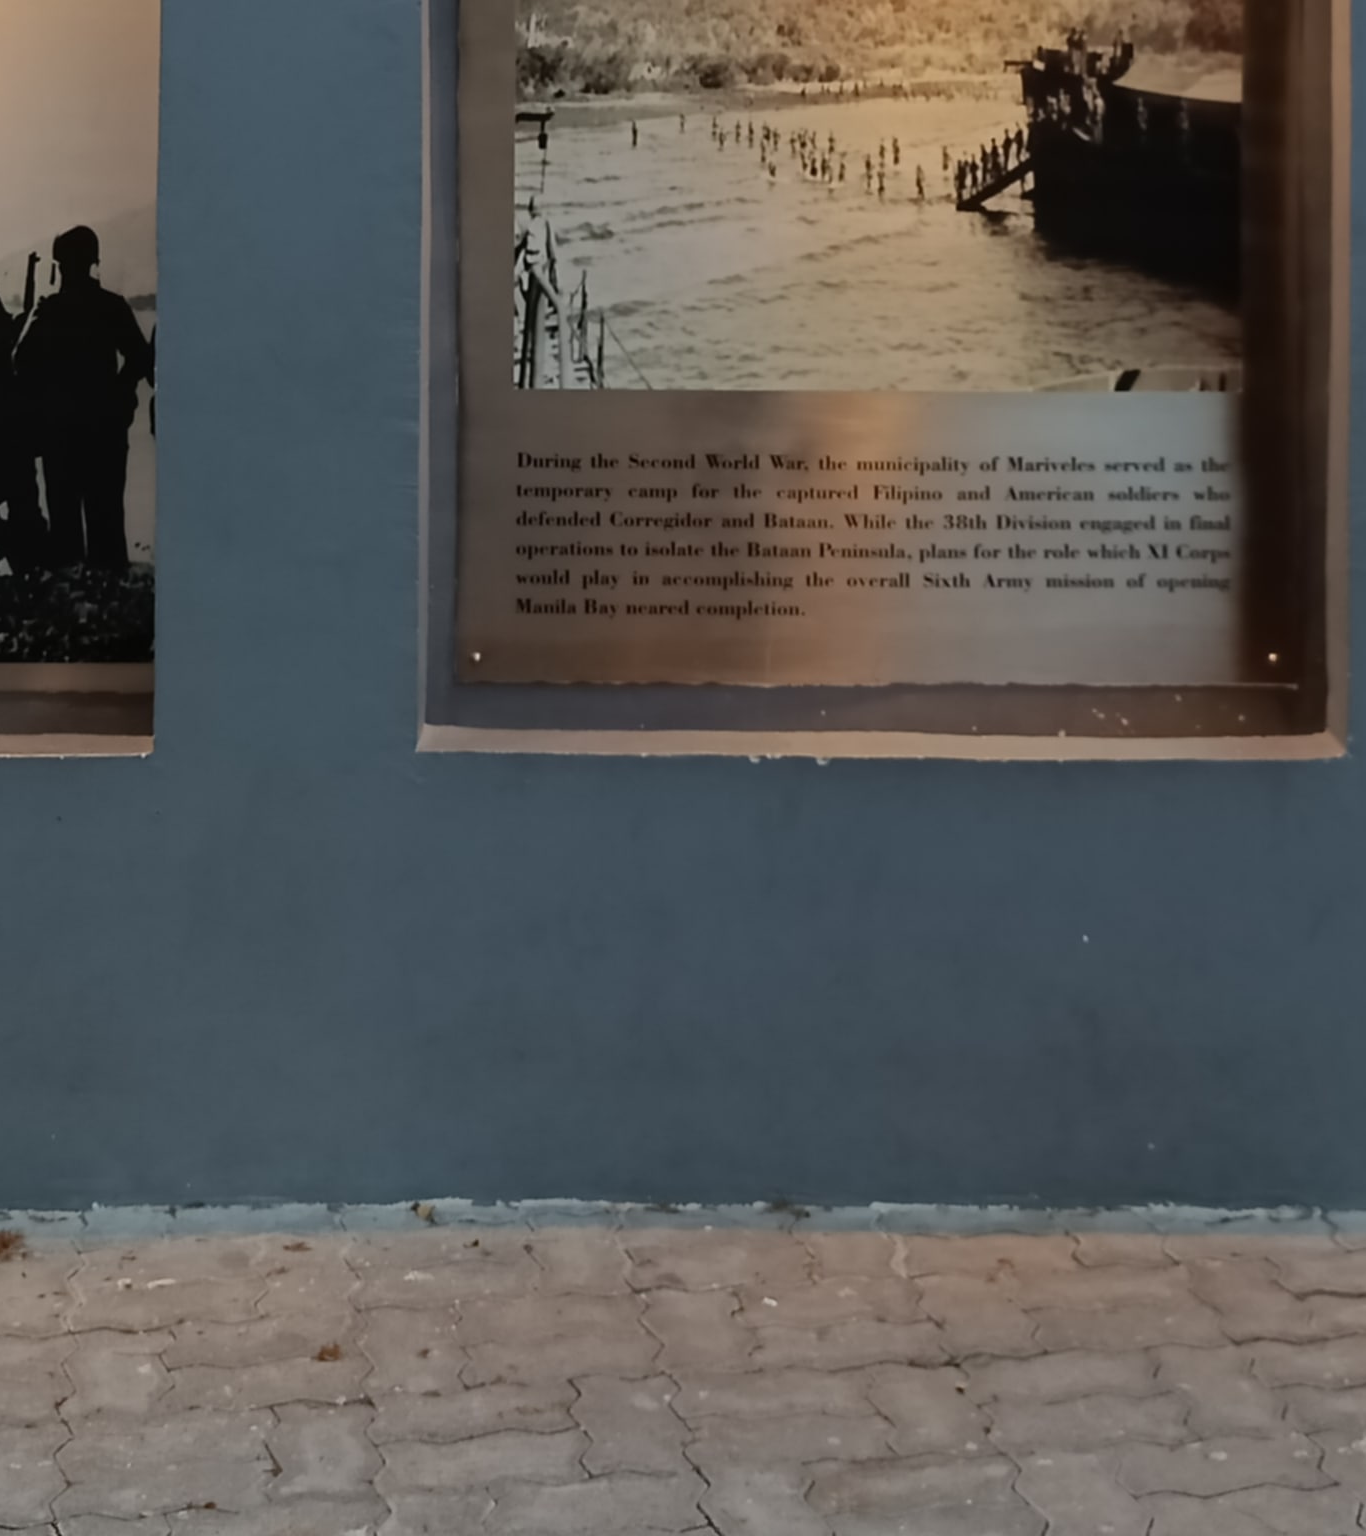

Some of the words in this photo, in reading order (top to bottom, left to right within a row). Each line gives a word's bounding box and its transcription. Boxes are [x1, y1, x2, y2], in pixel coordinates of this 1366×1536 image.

[517, 451, 582, 472] During
[590, 453, 619, 469] the
[628, 453, 696, 470] Second
[705, 453, 760, 471] World
[770, 452, 811, 473] War,
[818, 454, 847, 471] the
[856, 456, 969, 476] municipality
[978, 455, 999, 472] of
[1007, 456, 1096, 473] Mariveles
[1103, 456, 1166, 472] served
[1173, 462, 1193, 473] as
[1201, 457, 1230, 473] the
[515, 485, 613, 503] temporary
[627, 487, 679, 503] camp
[691, 483, 721, 499] for
[732, 483, 762, 499] the
[776, 484, 859, 504] captured
[873, 485, 944, 506] Filipino
[956, 485, 991, 501] and
[1004, 486, 1095, 501] American
[1107, 486, 1181, 502] soldiers
[1193, 486, 1231, 501] who
[515, 511, 602, 528] defended
[609, 512, 714, 533] Corregidor
[721, 512, 755, 529] and
[763, 512, 835, 529] Bataan.
[844, 513, 897, 530] While
[905, 514, 935, 530] the
[942, 513, 988, 530] 38th
[995, 515, 1072, 531] Division
[1078, 514, 1157, 534] engaged
[1163, 516, 1183, 530] in
[1188, 515, 1231, 531] final
[515, 541, 614, 561] operations
[619, 544, 639, 557] to
[644, 540, 704, 557] isolate
[710, 541, 740, 557] the
[746, 542, 812, 559] Bataan
[918, 543, 968, 563] plans
[973, 543, 1002, 560] for
[1007, 543, 1037, 560] the
[1043, 543, 1080, 559] role
[1087, 543, 1141, 559] which
[1148, 544, 1169, 560] XI
[1175, 544, 1231, 564] Corps
[515, 568, 571, 585] would
[581, 568, 619, 590] play
[632, 571, 650, 586] in
[661, 570, 794, 591] accomplishing
[805, 572, 834, 588] the
[846, 572, 911, 589] overall
[922, 572, 971, 588] Sixth
[982, 573, 1033, 593] Army
[1045, 574, 1115, 589] mission
[1125, 572, 1146, 589] of
[1156, 575, 1232, 594] opening
[514, 598, 577, 615] Manila
[583, 598, 619, 619] Bay
[625, 599, 690, 615] neared
